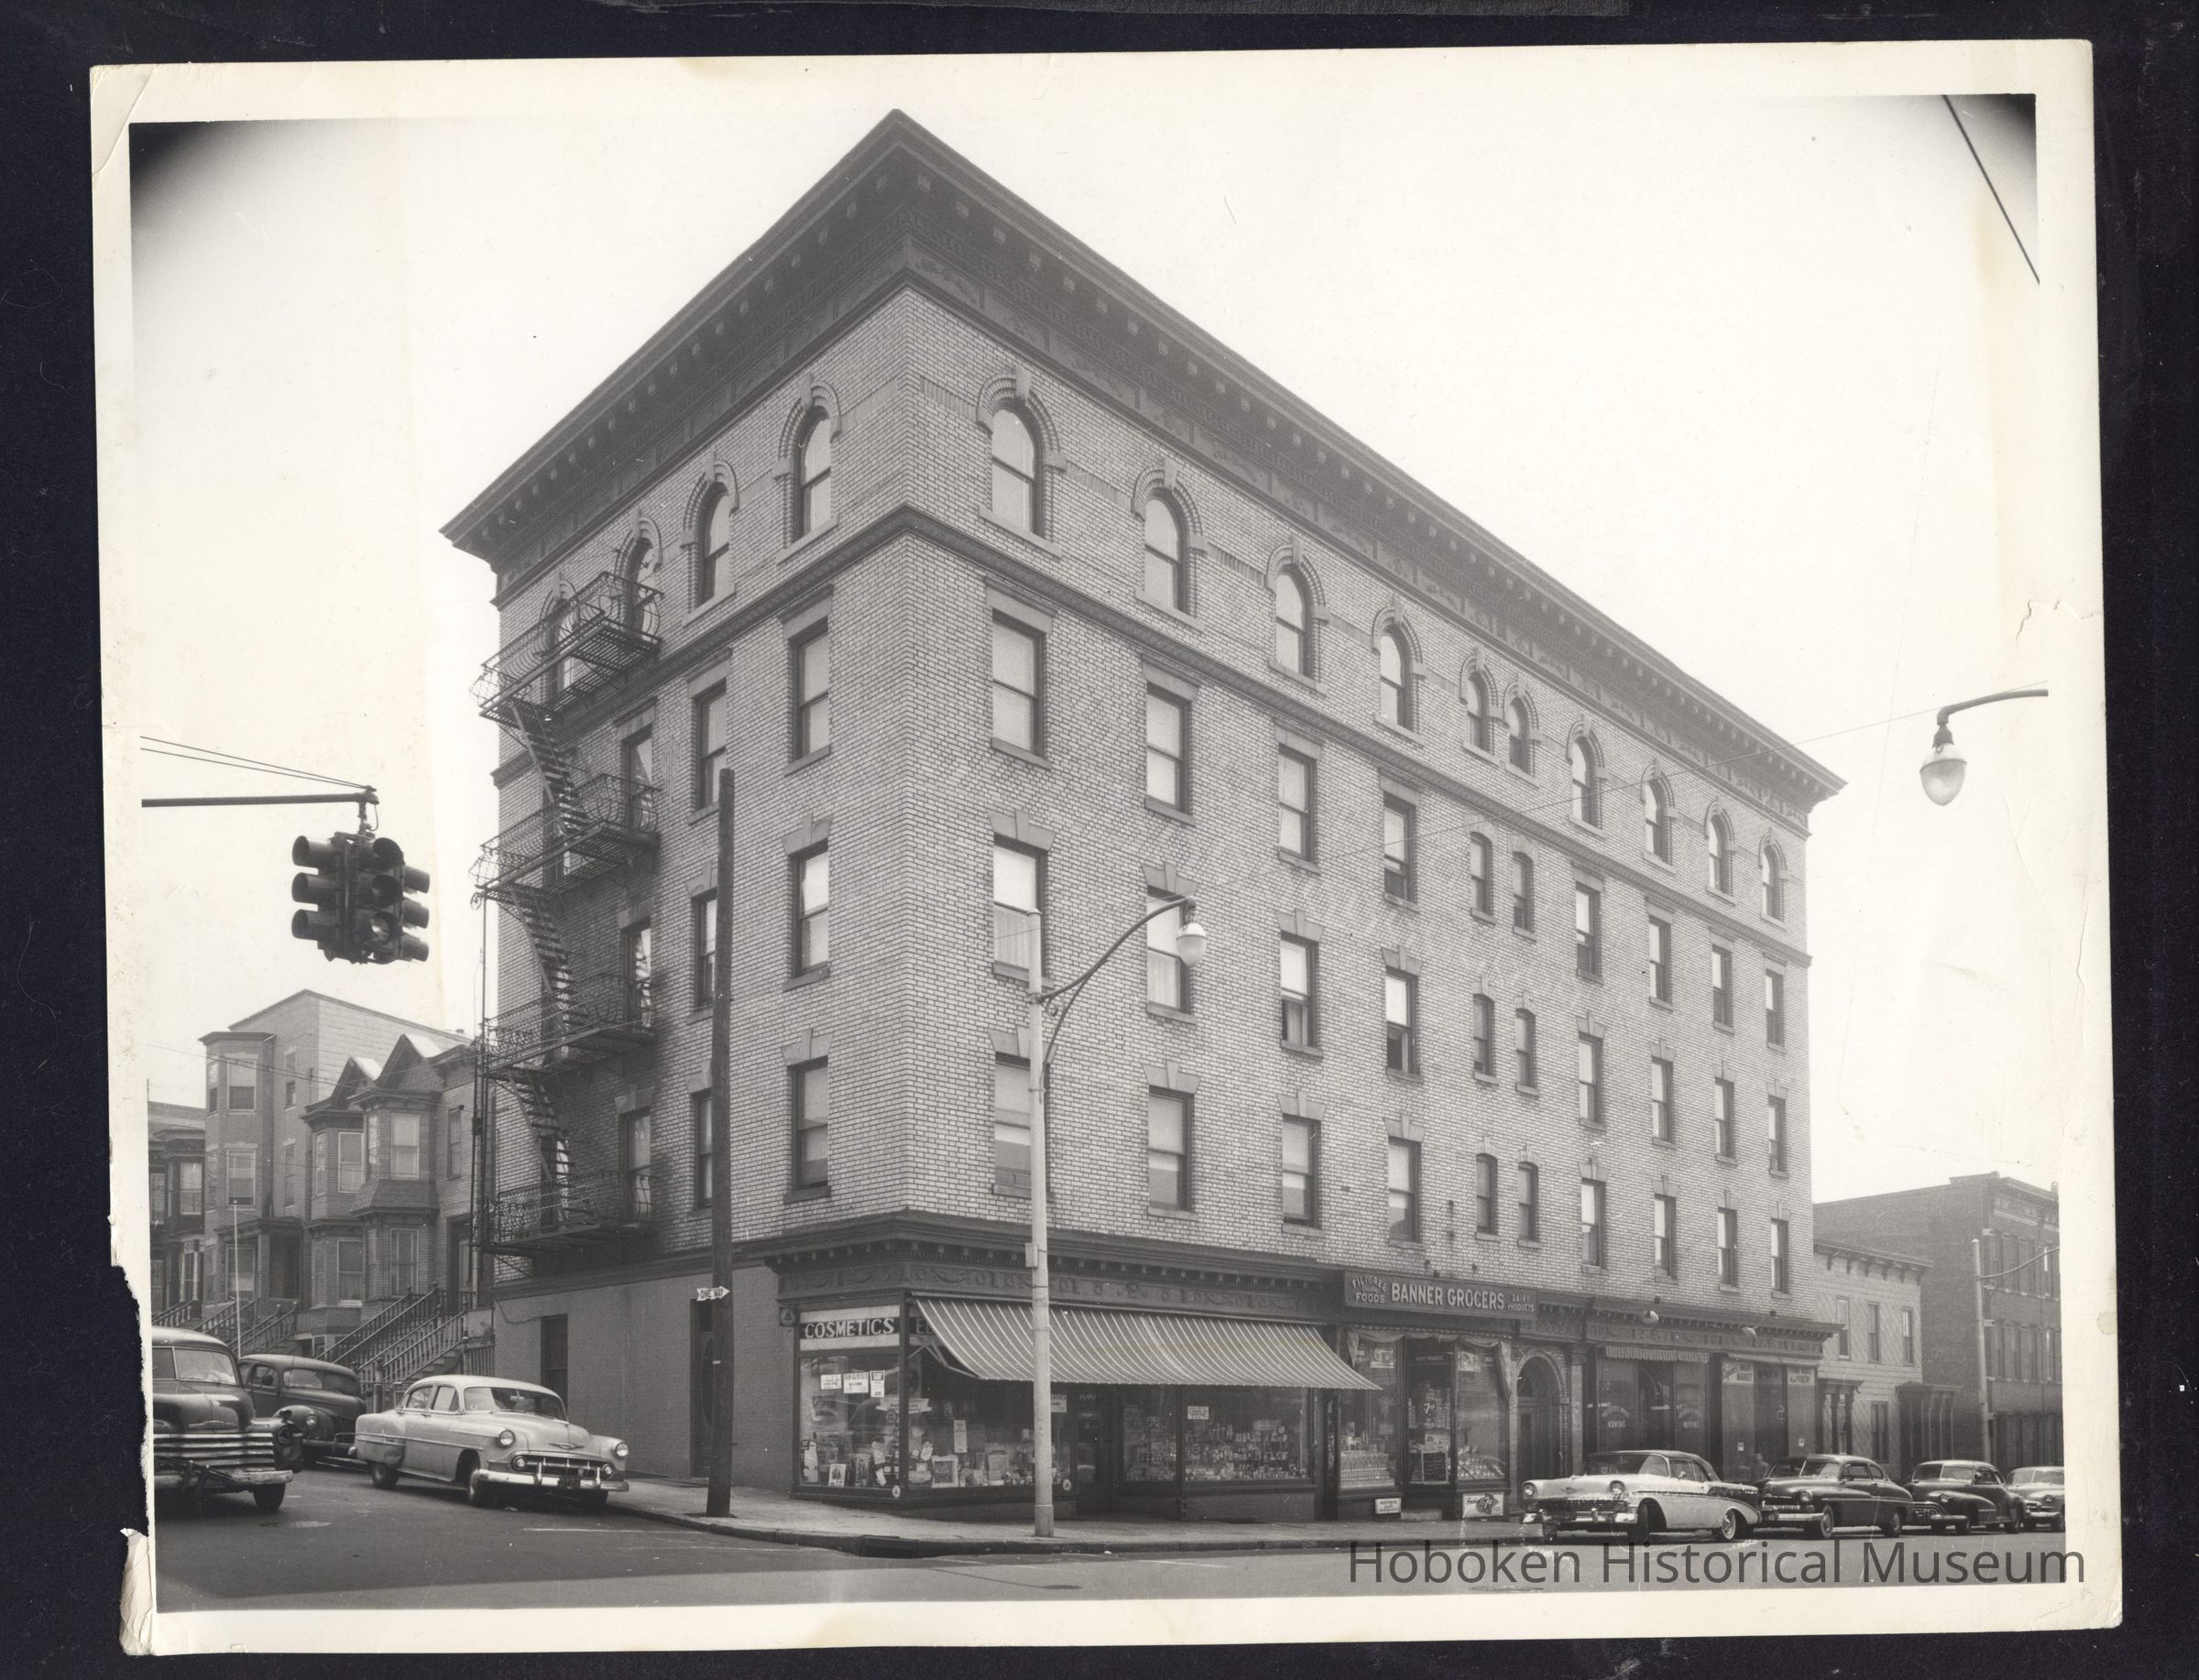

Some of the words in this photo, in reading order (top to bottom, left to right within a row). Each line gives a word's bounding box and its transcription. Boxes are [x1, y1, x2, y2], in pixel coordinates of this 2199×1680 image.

[700, 1289, 712, 1299] ONE
[714, 1288, 724, 1298] WAY
[1356, 1292, 1385, 1304] FOODS
[1391, 1282, 1443, 1305] BANNER
[1448, 1288, 1504, 1310] GROCERS
[1512, 1293, 1529, 1303] DAIRY
[1507, 1304, 1535, 1313] PRODUCTS
[804, 1317, 895, 1338] COSMETICS
